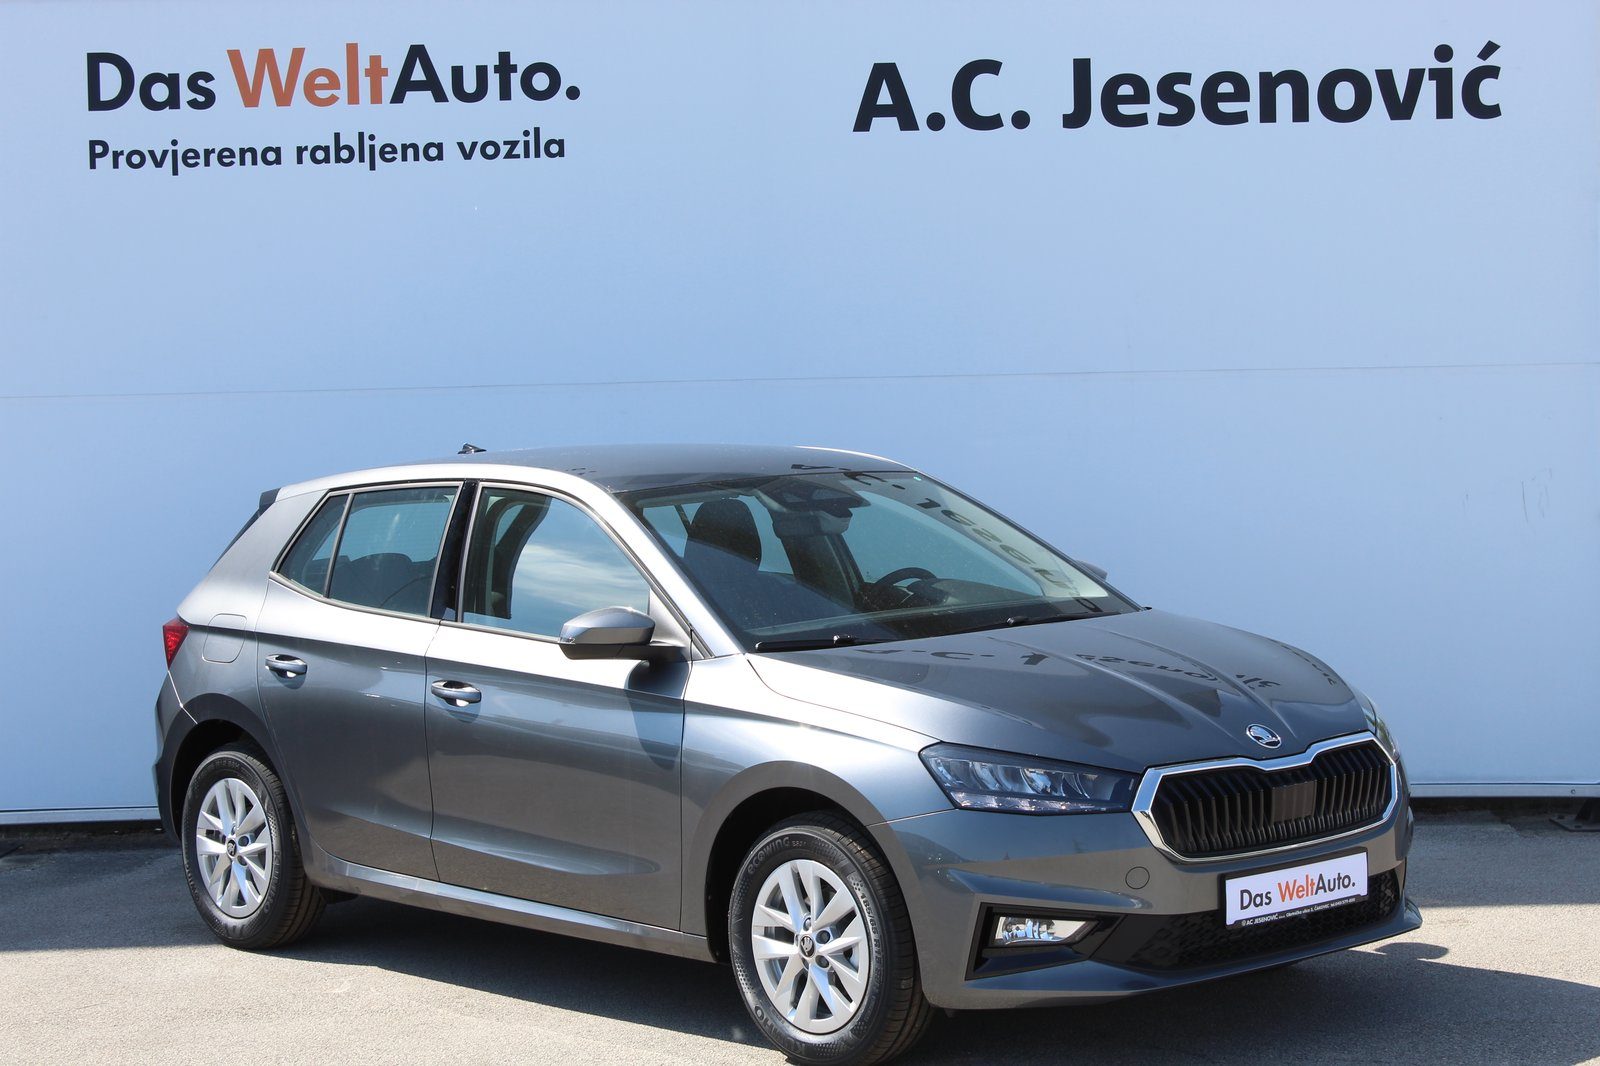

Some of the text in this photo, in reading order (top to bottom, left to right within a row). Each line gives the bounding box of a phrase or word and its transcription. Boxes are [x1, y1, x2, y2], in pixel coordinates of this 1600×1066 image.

[87, 43, 580, 111] Das WeltAuto.
[853, 40, 1502, 132] A.C. Jesenović
[89, 127, 564, 176] Provjerena rabljena vozila
[1240, 873, 1356, 910] Das WeltAuto.
